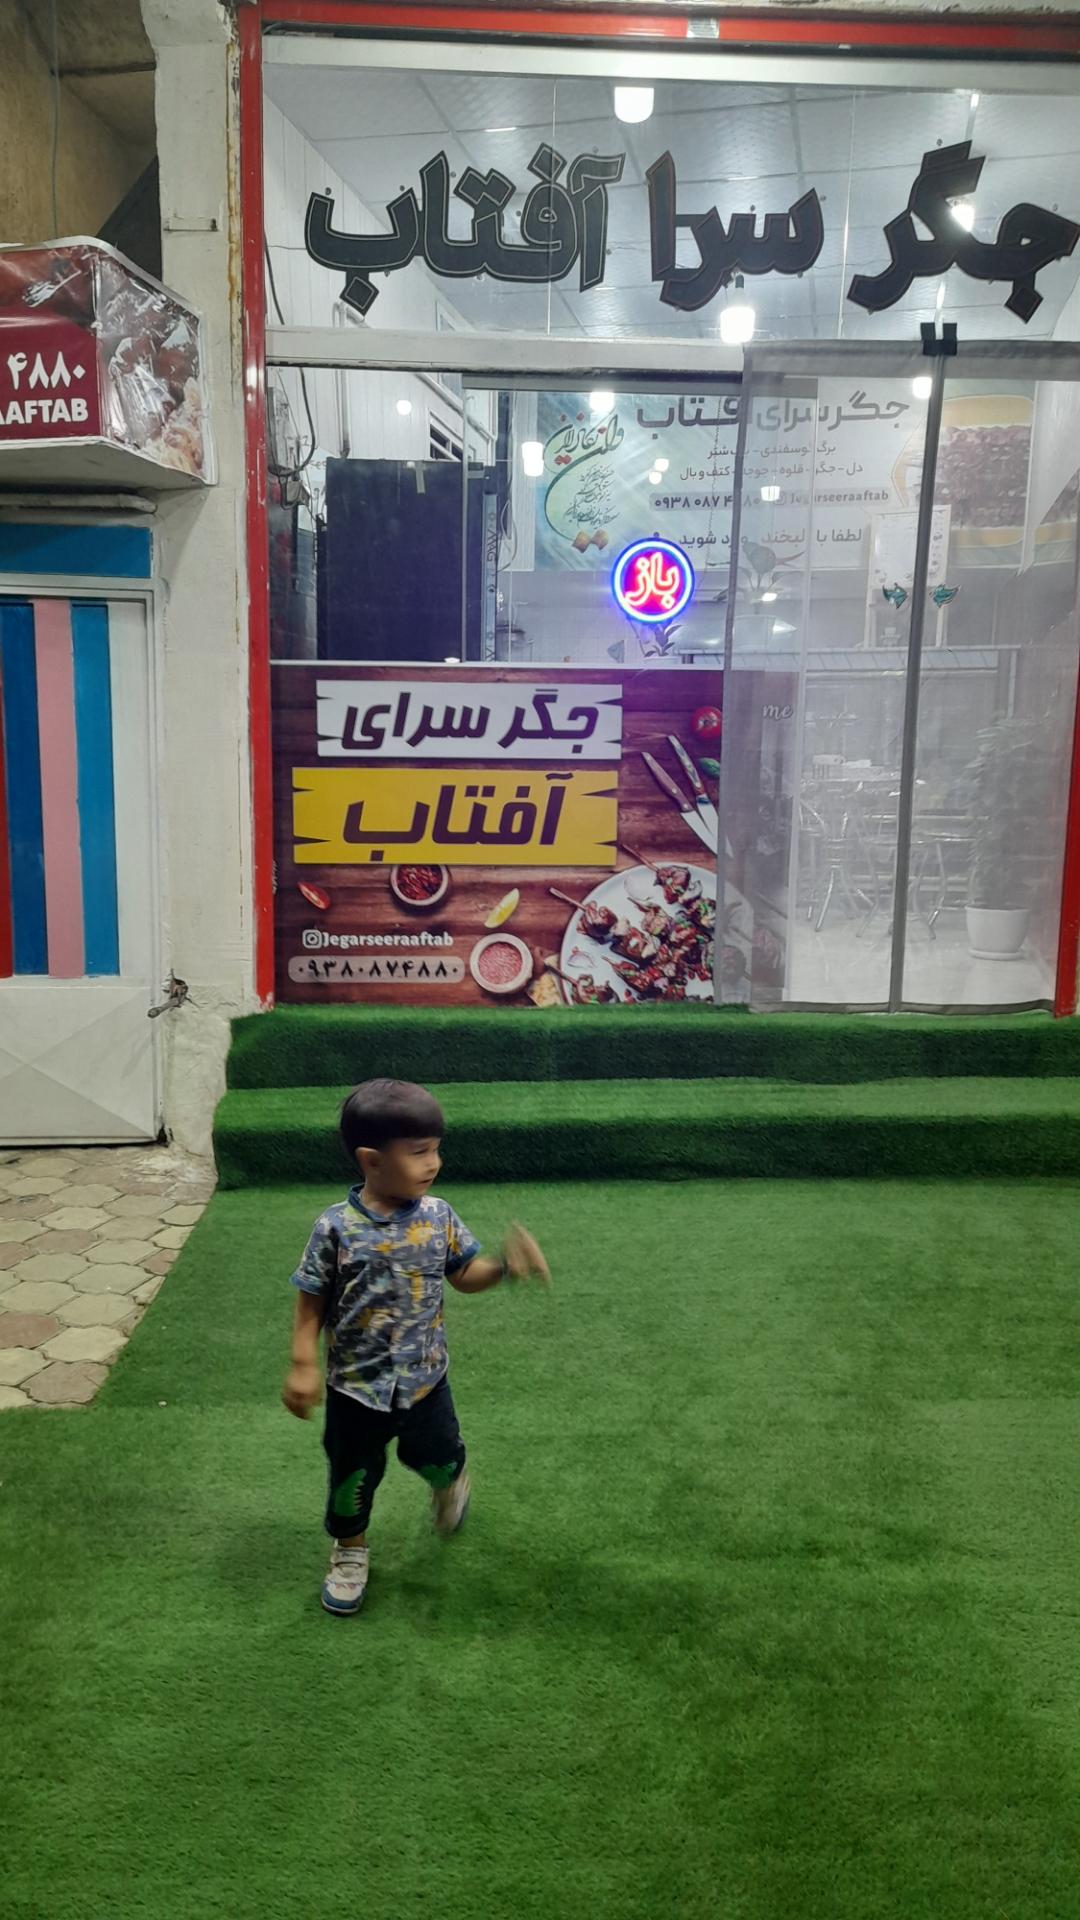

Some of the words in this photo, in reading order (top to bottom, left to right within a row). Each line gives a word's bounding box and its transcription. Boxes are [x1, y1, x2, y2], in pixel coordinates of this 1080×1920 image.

[305, 142, 626, 315] آفتاب
[646, 150, 824, 311] سرا
[847, 140, 1080, 323] جگر
[7, 350, 86, 390] ۴۸۸۰
[625, 552, 681, 609] باز
[342, 692, 490, 750] سرای
[498, 688, 599, 753] جگر
[343, 772, 574, 861] آفتاب
